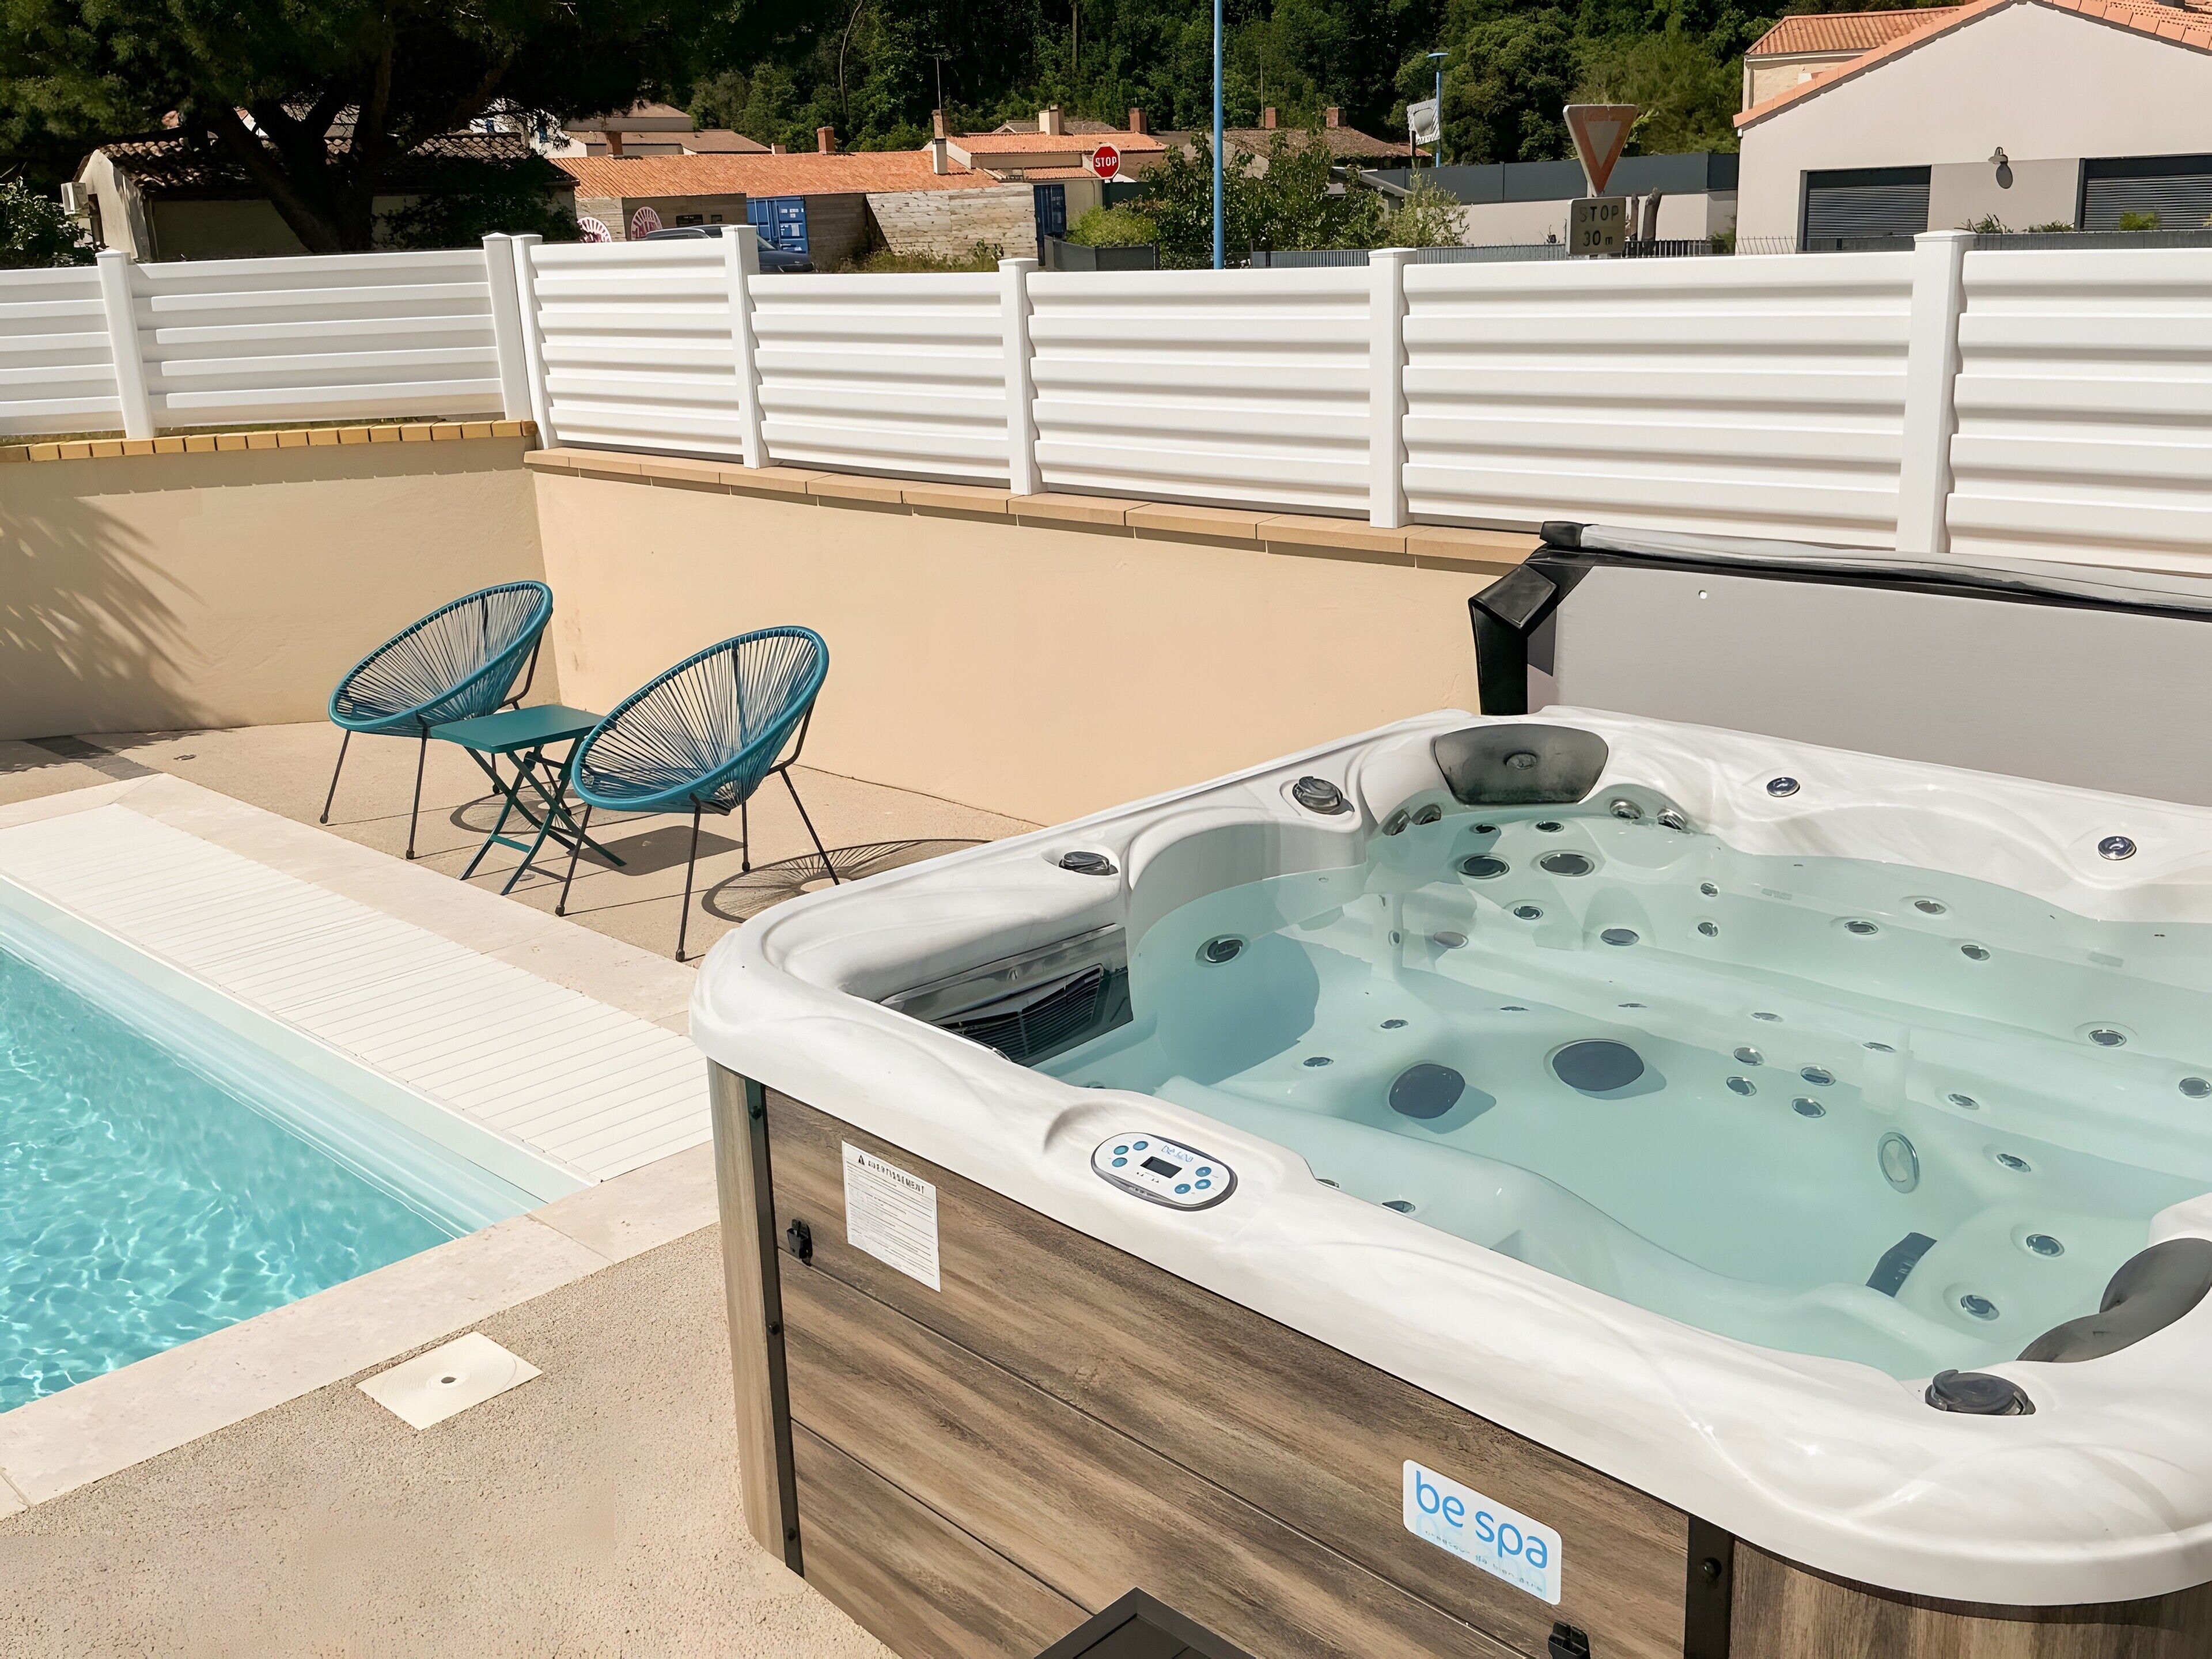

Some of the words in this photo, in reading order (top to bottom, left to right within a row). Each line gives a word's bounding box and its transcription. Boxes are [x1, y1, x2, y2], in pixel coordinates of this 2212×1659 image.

[1095, 156, 1117, 168] STOP
[1580, 204, 1619, 222] STOP
[1583, 230, 1601, 247] 30
[1605, 236, 1613, 246] m
[1416, 1470, 1465, 1528] be
[1475, 1510, 1548, 1569] spa
